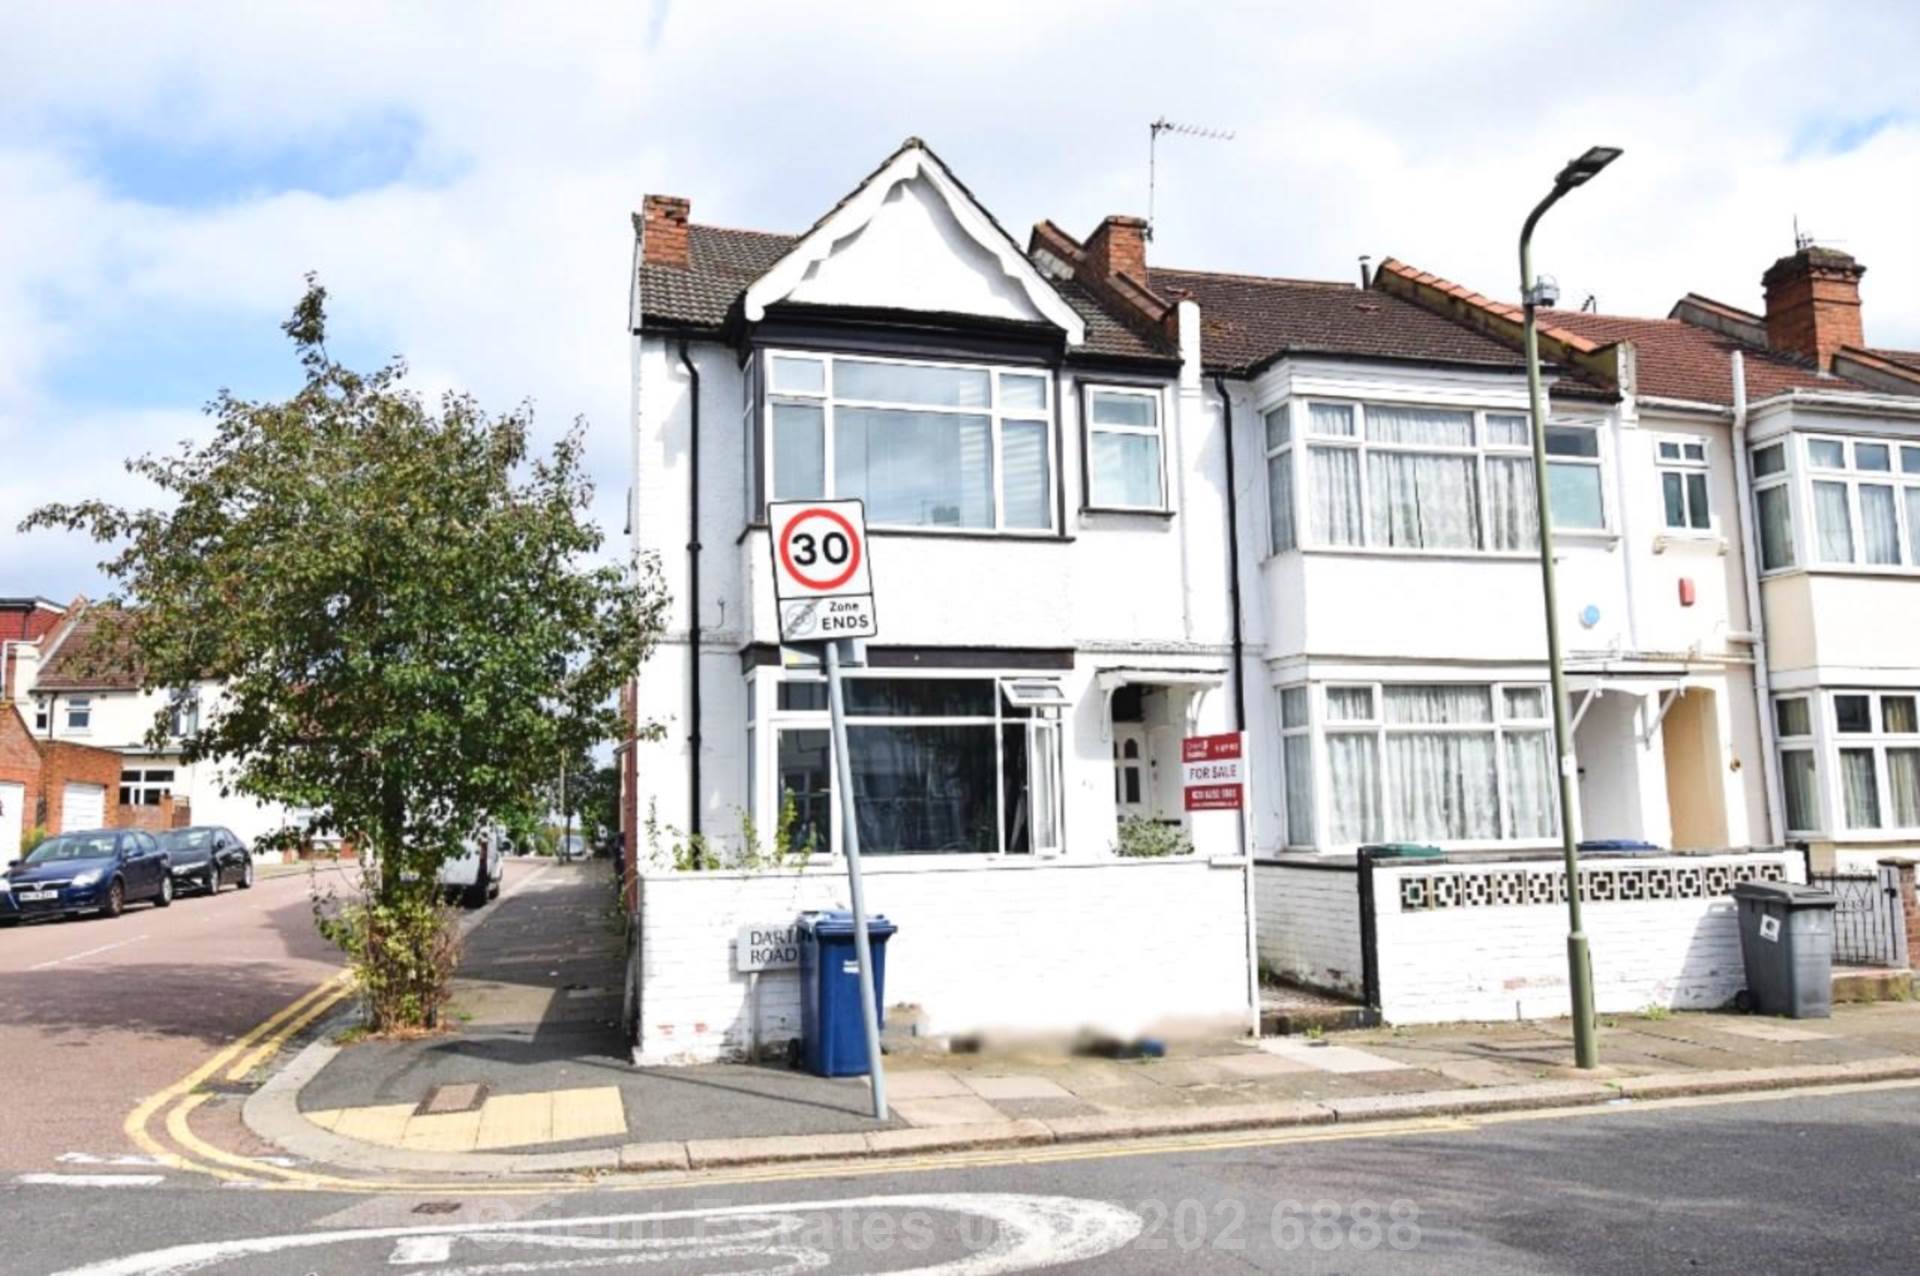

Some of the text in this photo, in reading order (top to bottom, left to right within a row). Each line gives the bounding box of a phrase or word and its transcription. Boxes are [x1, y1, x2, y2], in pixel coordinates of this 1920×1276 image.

[792, 532, 849, 566] 30
[829, 601, 860, 613] Zone
[822, 614, 870, 631] ENDS
[1189, 763, 1238, 780] FOR SALE
[749, 947, 798, 965] ROAD
